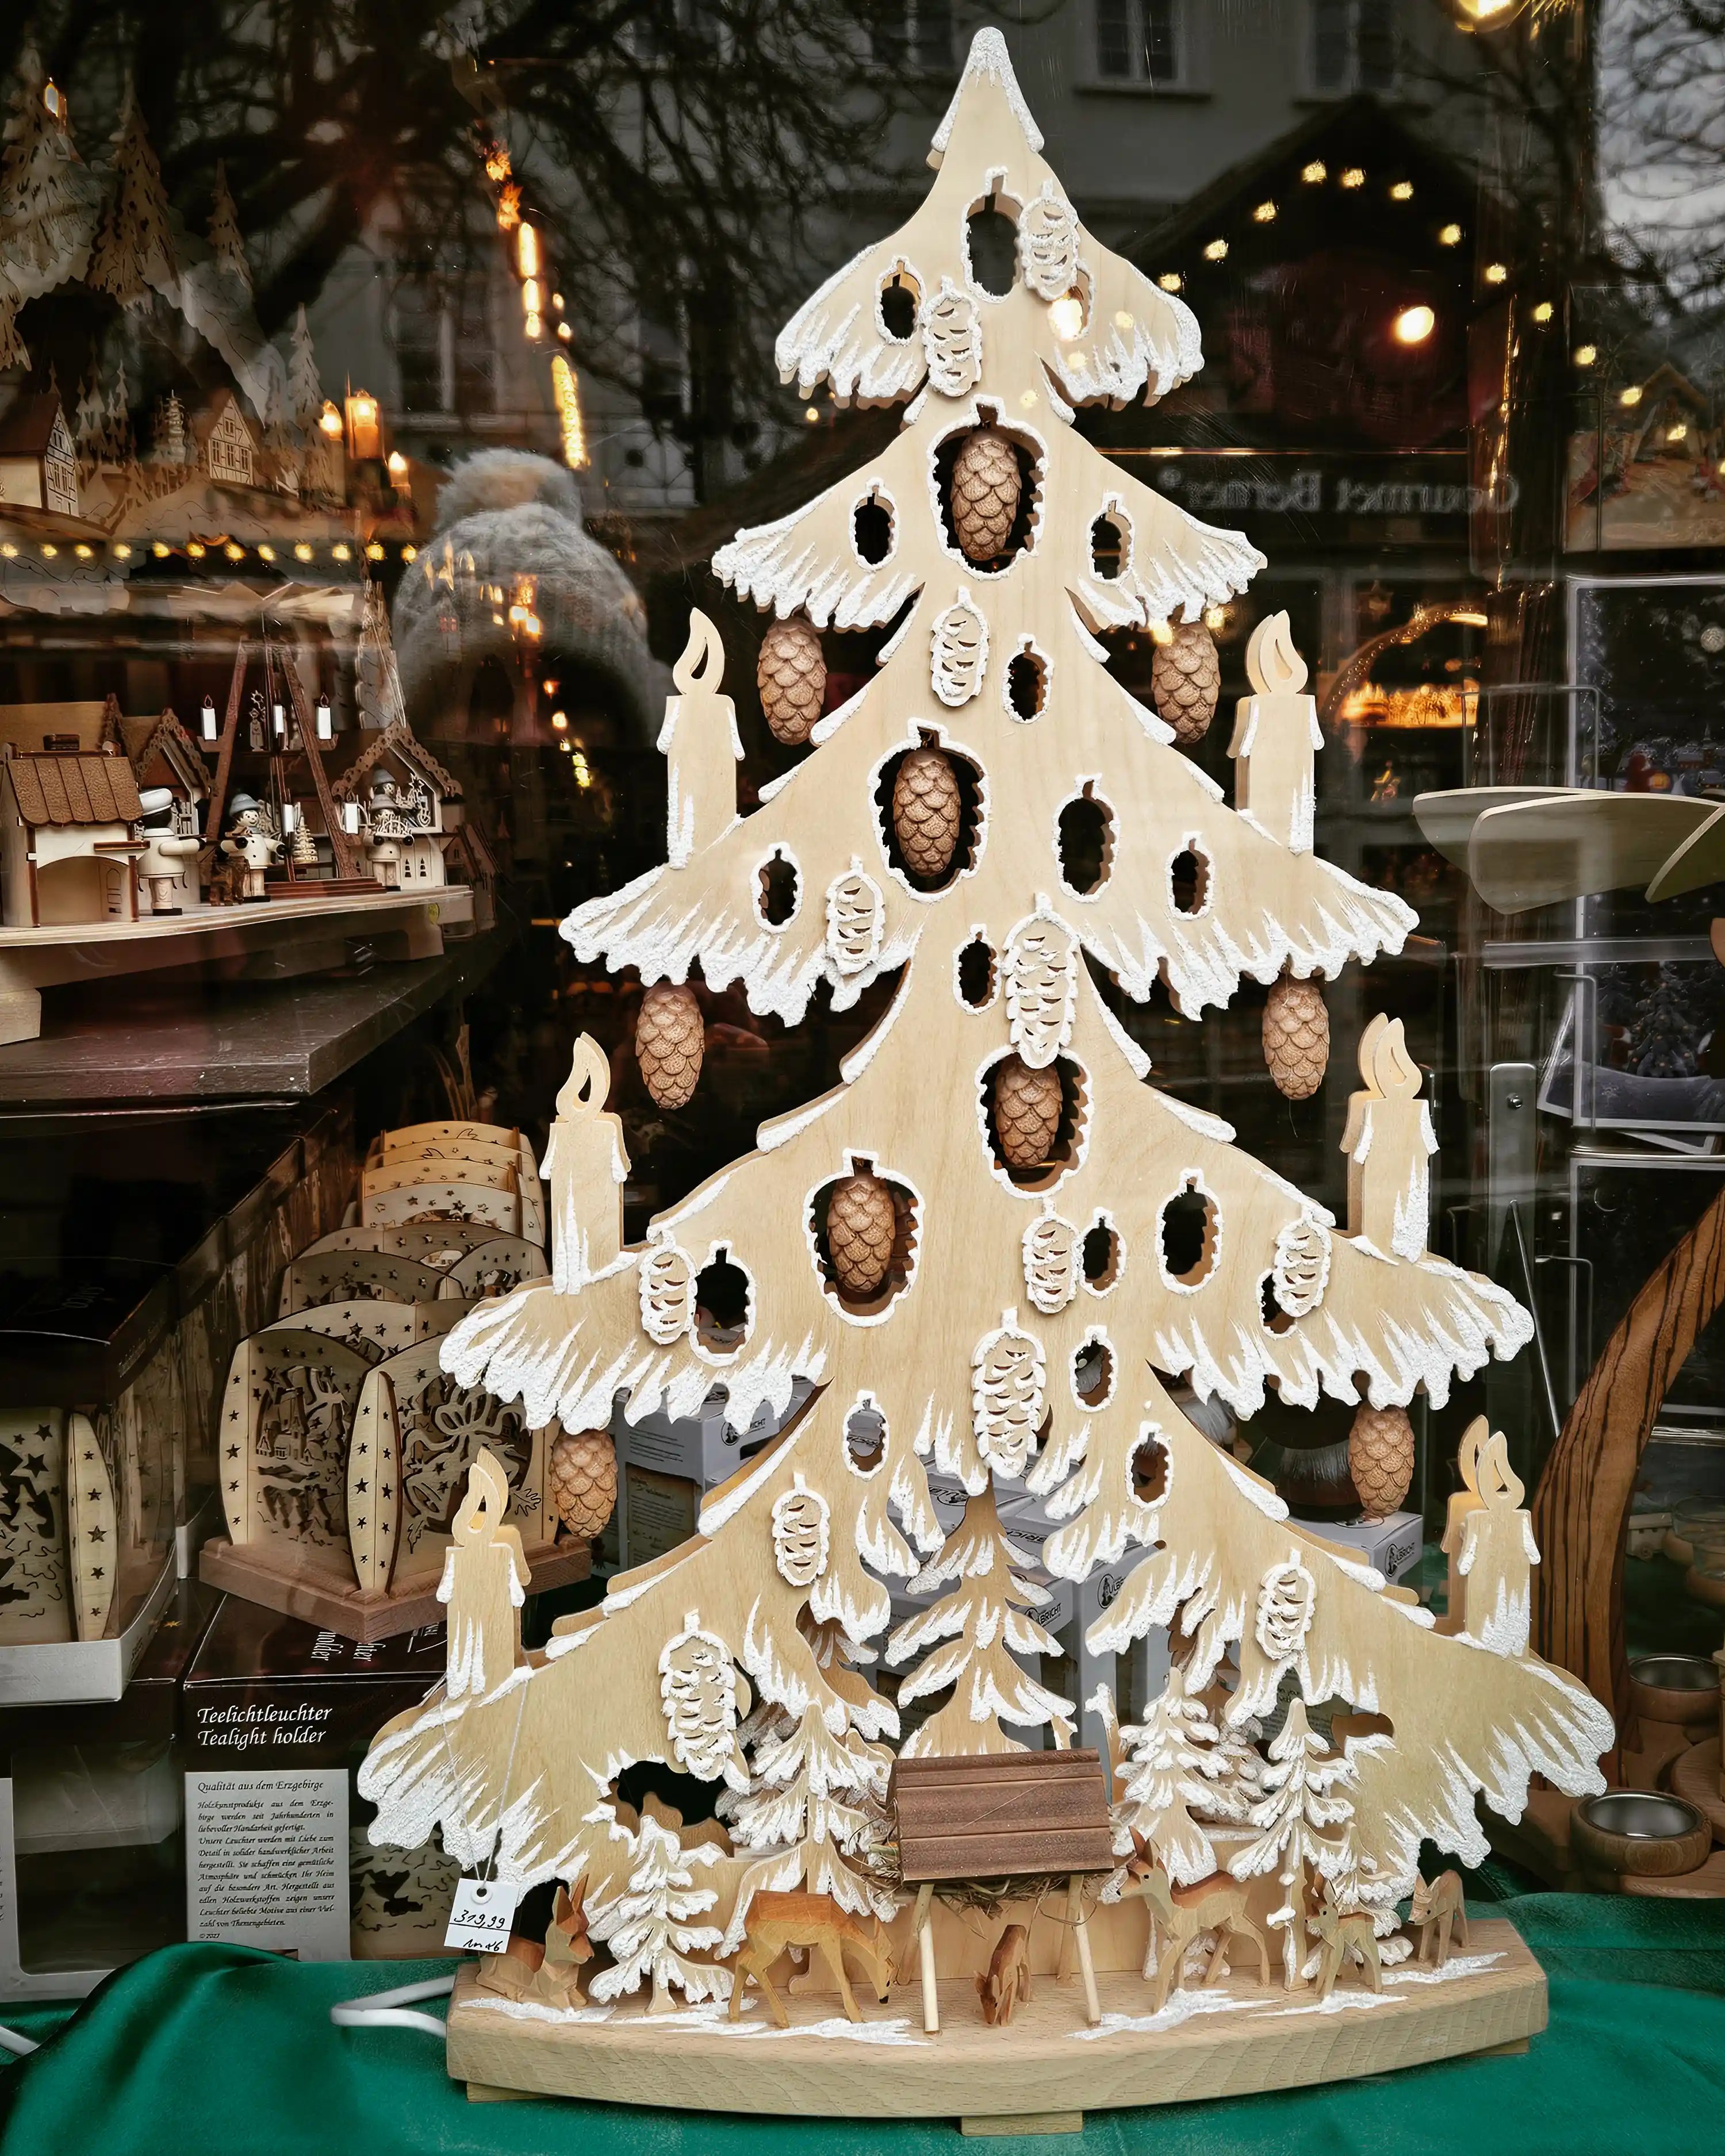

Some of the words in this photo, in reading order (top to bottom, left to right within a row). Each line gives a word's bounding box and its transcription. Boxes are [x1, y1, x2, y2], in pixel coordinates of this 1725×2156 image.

[197, 1703, 333, 1724] Teelichtleuchter
[198, 1727, 267, 1750] Tealight
[273, 1725, 327, 1744] holder
[198, 1781, 235, 1793] Qualität
[256, 1780, 273, 1789] dem
[275, 1779, 323, 1791] Erzgebirge
[289, 1799, 305, 1808] dem
[198, 1813, 215, 1823] birge
[221, 1812, 246, 1820] werden
[198, 1824, 233, 1833] liebevoller
[198, 1837, 223, 1845] Unsere
[225, 1836, 256, 1844] Leuchter
[258, 1835, 282, 1843] werden
[284, 1835, 296, 1843] mit
[298, 1833, 317, 1843] Liebe
[198, 1848, 222, 1857] Detail
[232, 1847, 256, 1856] solider
[310, 1846, 334, 1855] Arbeit
[238, 1860, 249, 1869] Sie
[251, 1859, 280, 1870] schaffen
[282, 1859, 296, 1867] eine
[197, 1871, 240, 1883] Atmosphäre
[243, 1871, 258, 1879] und
[301, 1870, 314, 1878] Ihr
[315, 1869, 335, 1878] Heim
[198, 1883, 212, 1894] auf
[214, 1883, 225, 1892] die
[281, 1881, 319, 1892] Hergestellt
[199, 1896, 217, 1904] edlen
[222, 1894, 280, 1905] Holzwerkstoffen
[285, 1894, 308, 1904] zeigen
[199, 1907, 231, 1916] Leuchter
[231, 1906, 258, 1916] beliebte
[258, 1906, 285, 1915] Motive
[199, 1919, 216, 1927] zahl
[454, 1909, 505, 1929] 319,99
